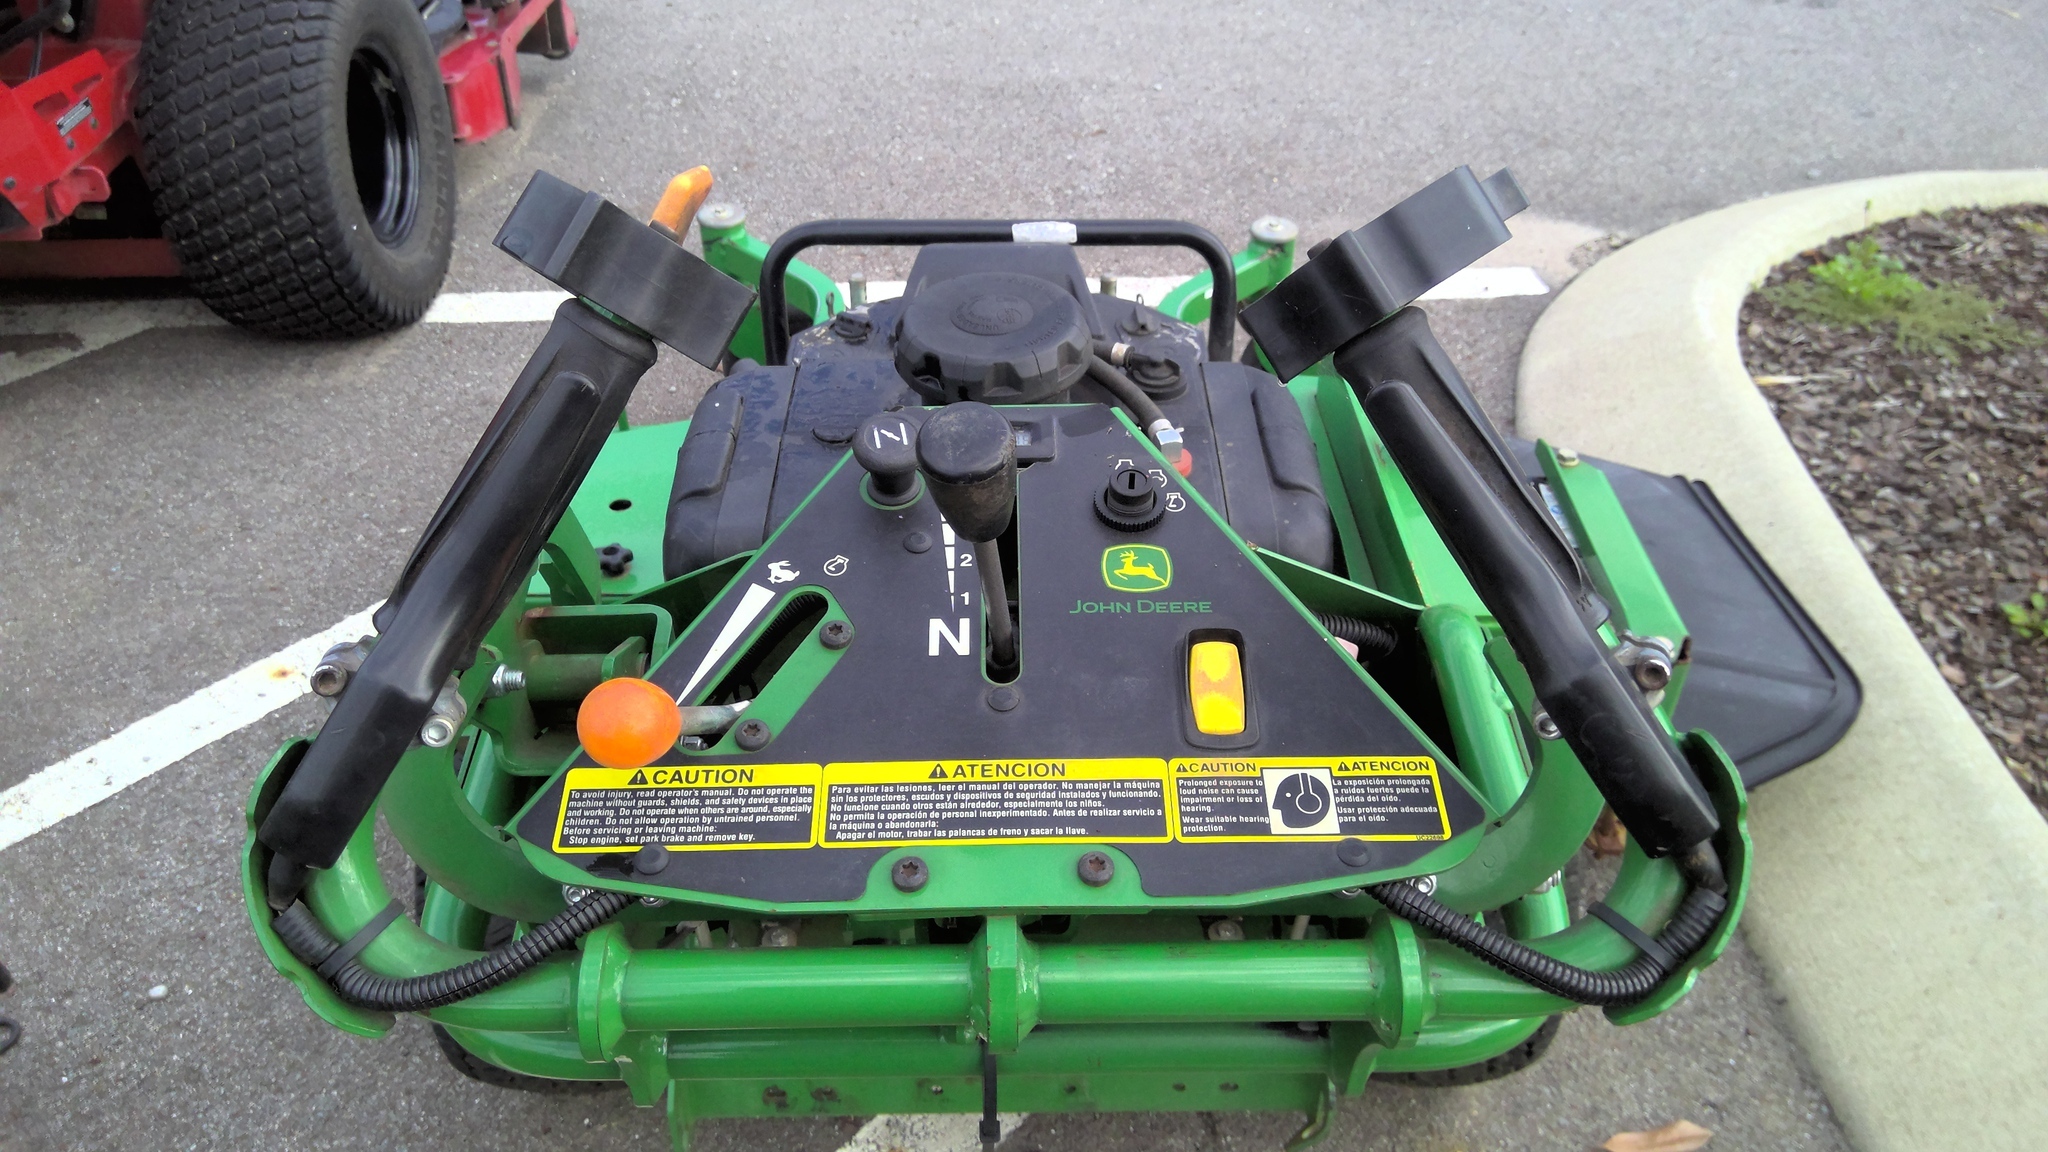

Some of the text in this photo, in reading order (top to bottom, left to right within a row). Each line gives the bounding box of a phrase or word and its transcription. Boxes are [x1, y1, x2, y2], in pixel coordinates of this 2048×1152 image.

[960, 554, 972, 567] 2
[960, 592, 970, 605] 1
[1070, 600, 1212, 614] JOHN DEERE
[928, 618, 970, 656] N
[953, 763, 1066, 778] ATENCION
[1190, 763, 1256, 772] CAUTION
[1352, 761, 1430, 771] ATENCION
[652, 769, 754, 784] CAUTION
[1344, 778, 1385, 787] exposición
[1387, 778, 1430, 786] prolongada
[854, 785, 879, 793] evitar
[881, 785, 894, 793] las
[896, 784, 935, 793] lesiones,
[938, 784, 955, 792] leer
[969, 783, 1000, 791] manual
[1002, 783, 1016, 791] del
[1018, 782, 1059, 792] operador.
[1061, 782, 1073, 790] No
[1076, 782, 1111, 791] manejar
[1113, 781, 1121, 789] la
[1123, 781, 1160, 790] máquina
[1178, 779, 1217, 787] Prolonged
[582, 790, 605, 798] avoid
[607, 790, 634, 799] injury,
[636, 789, 655, 797] read
[657, 789, 699, 798] operator's
[701, 788, 735, 796] manual.
[751, 787, 764, 795] not
[766, 787, 798, 796] operate
[800, 786, 813, 794] the
[1396, 786, 1419, 794] puede
[568, 796, 812, 808] machine without guards, shields, and safety devices in place
[831, 795, 843, 803] sin
[860, 794, 909, 803] protectores,
[911, 793, 945, 801] escudos
[953, 792, 1002, 802] dispositivos
[1004, 792, 1014, 800] de
[1016, 791, 1056, 801] seguridad
[1058, 791, 1100, 799] instalados
[1109, 790, 1161, 798] funcionando.
[1180, 796, 1224, 804] impairment
[1335, 795, 1365, 803] pérdida
[583, 808, 617, 818] working.
[646, 807, 676, 816] operate
[700, 806, 725, 814] others
[740, 805, 770, 814] around,
[772, 804, 812, 814] especially
[844, 803, 879, 811] funcione
[912, 802, 934, 810] otros
[935, 802, 958, 810] están
[960, 801, 1001, 810] alrededor,
[1004, 800, 1063, 810] especialmente
[1080, 799, 1105, 807] niños.
[1357, 806, 1398, 815] protección
[1400, 805, 1438, 813] adecuada
[564, 813, 800, 826] children. Do not allow operation by untrained personnel.
[843, 812, 875, 822] permita
[877, 812, 884, 820] la
[887, 812, 928, 821] operación
[929, 811, 940, 819] de
[942, 811, 977, 820] personal
[979, 810, 1050, 820] inexperimentado.
[1052, 809, 1076, 817] Antes
[1077, 809, 1088, 817] de
[1122, 808, 1155, 816] servicio
[1239, 816, 1270, 824] hearing
[563, 827, 591, 835] Before
[593, 826, 632, 835] servicing
[645, 825, 676, 835] leaving
[678, 824, 718, 833] machine:
[829, 822, 837, 830] la
[840, 821, 875, 831] máquina
[885, 820, 939, 828] abandonarla:
[1183, 825, 1226, 833] protection.
[568, 836, 588, 845] Stop
[590, 835, 622, 845] engine,
[624, 835, 638, 843] set
[640, 835, 659, 844] park
[661, 834, 685, 842] brake
[738, 833, 755, 842] key.
[835, 831, 866, 841] Apagar
[867, 831, 876, 839] el
[878, 830, 904, 839] motor,
[906, 830, 932, 838] trabar
[934, 829, 946, 837] las
[948, 829, 986, 838] palancas
[987, 828, 998, 836] de
[1000, 828, 1022, 836] freno
[1023, 829, 1028, 837] y
[1055, 827, 1063, 835] la
